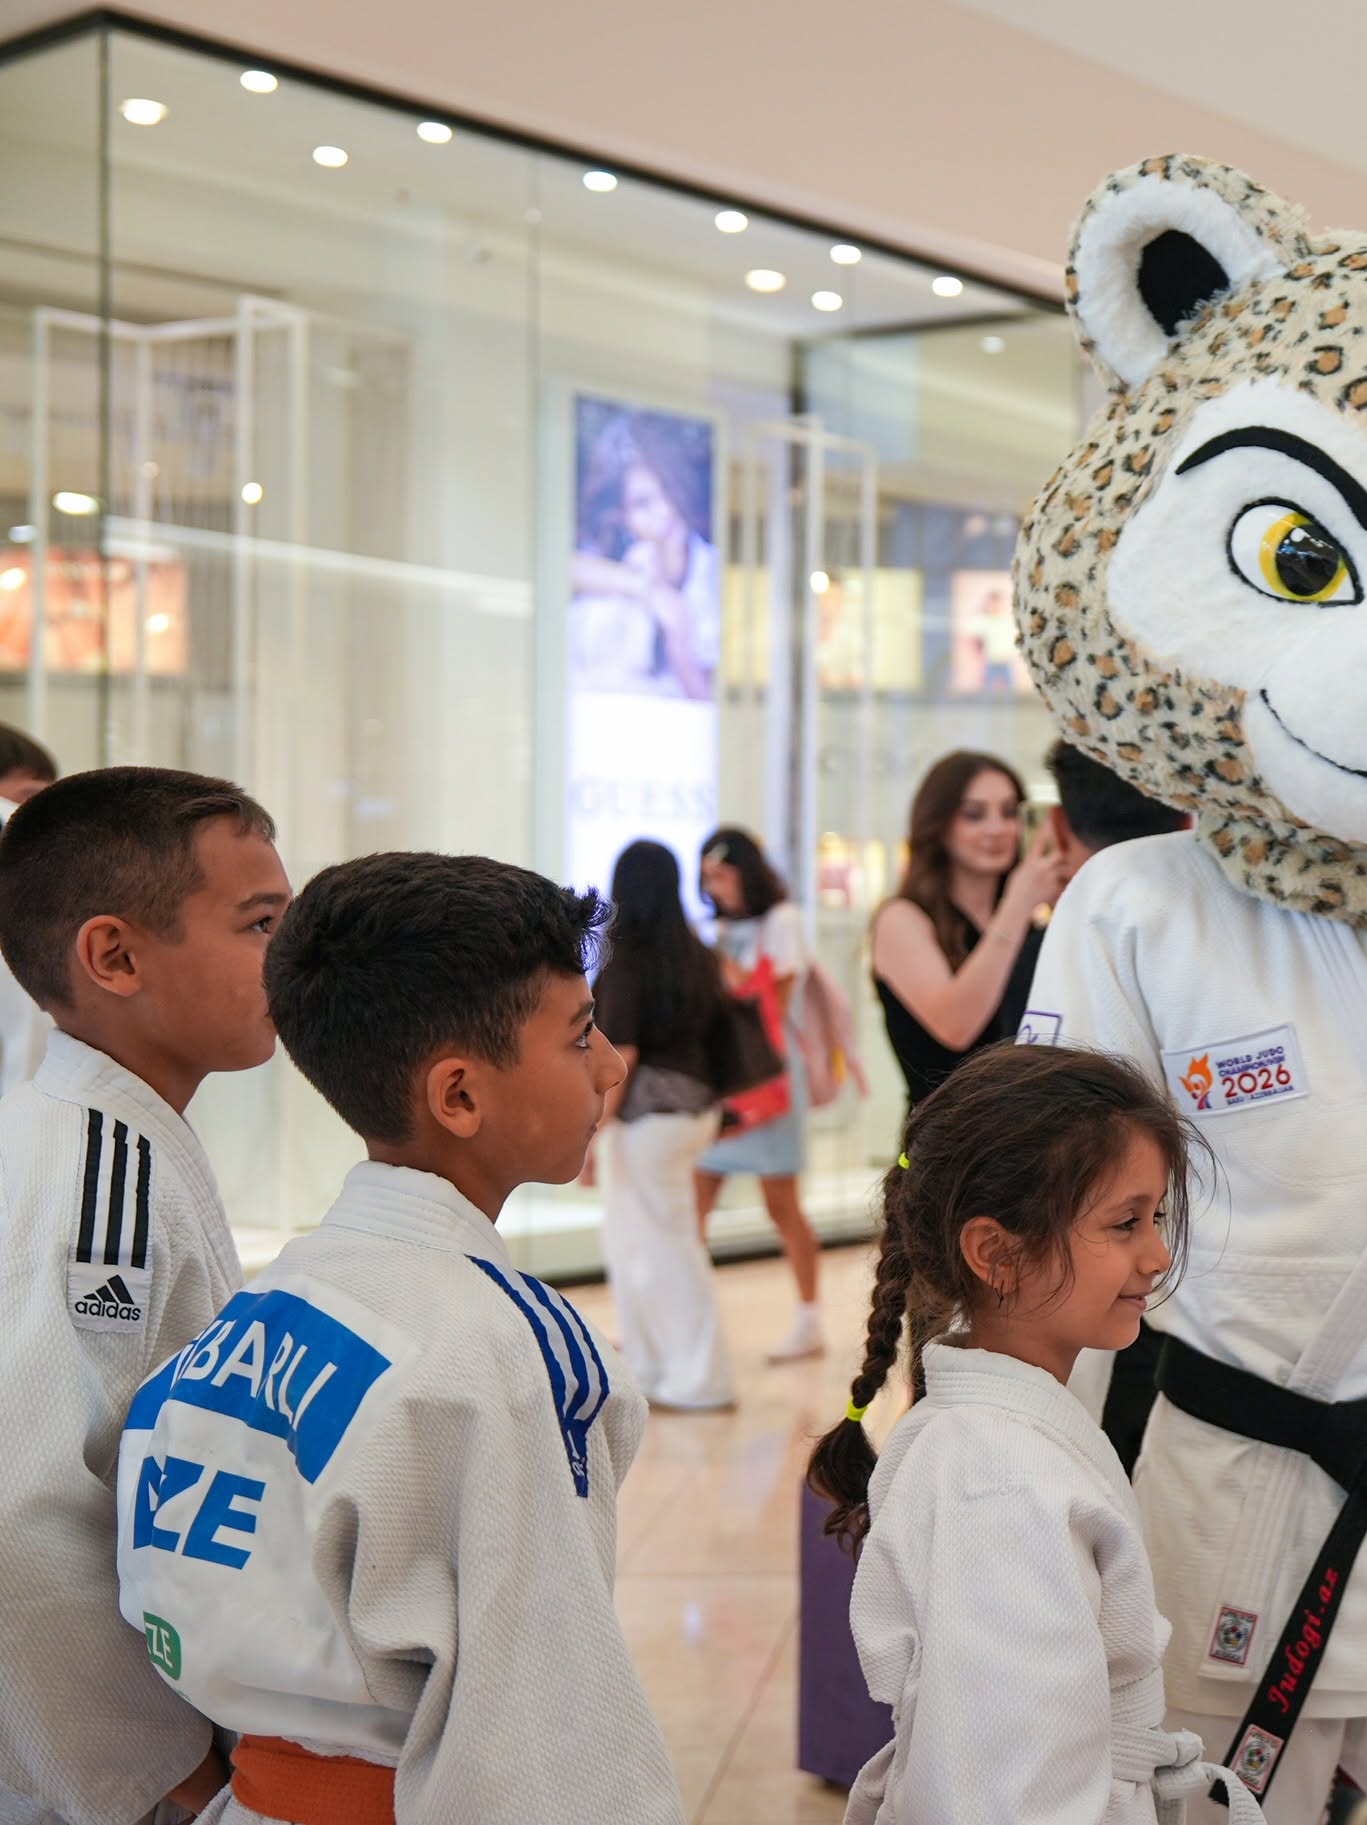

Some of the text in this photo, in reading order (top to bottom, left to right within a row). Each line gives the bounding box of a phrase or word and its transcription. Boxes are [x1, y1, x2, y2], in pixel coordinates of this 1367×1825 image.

[1256, 1046, 1284, 1060] JUDO
[1222, 1064, 1291, 1098] 2026
[75, 1300, 141, 1321] adidas
[145, 1622, 173, 1668] ZE
